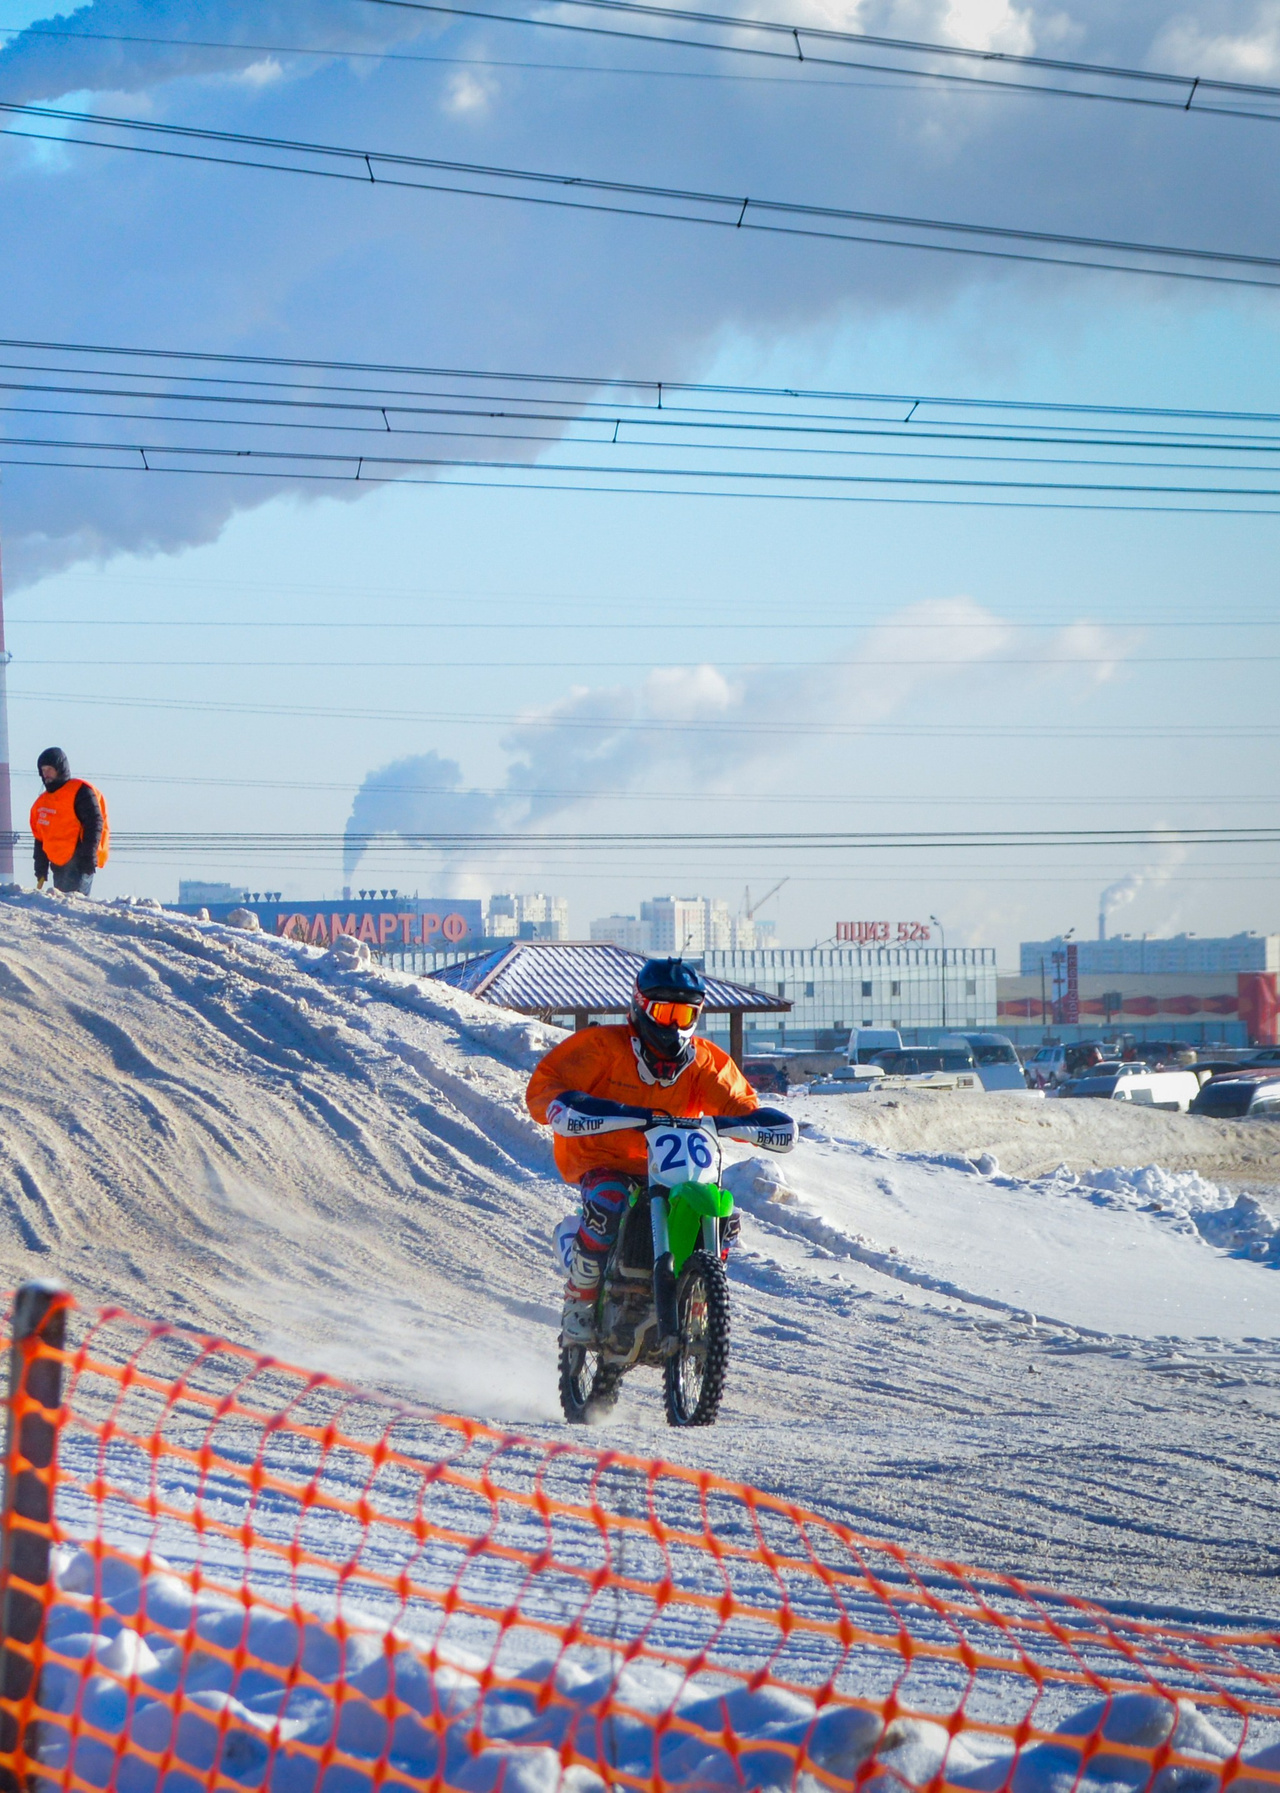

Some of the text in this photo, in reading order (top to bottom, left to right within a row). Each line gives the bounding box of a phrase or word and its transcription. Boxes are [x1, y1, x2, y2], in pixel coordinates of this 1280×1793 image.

[836, 921, 890, 944] ПЦИЗ
[653, 1061, 677, 1079] 17
[655, 1132, 712, 1173] 26
